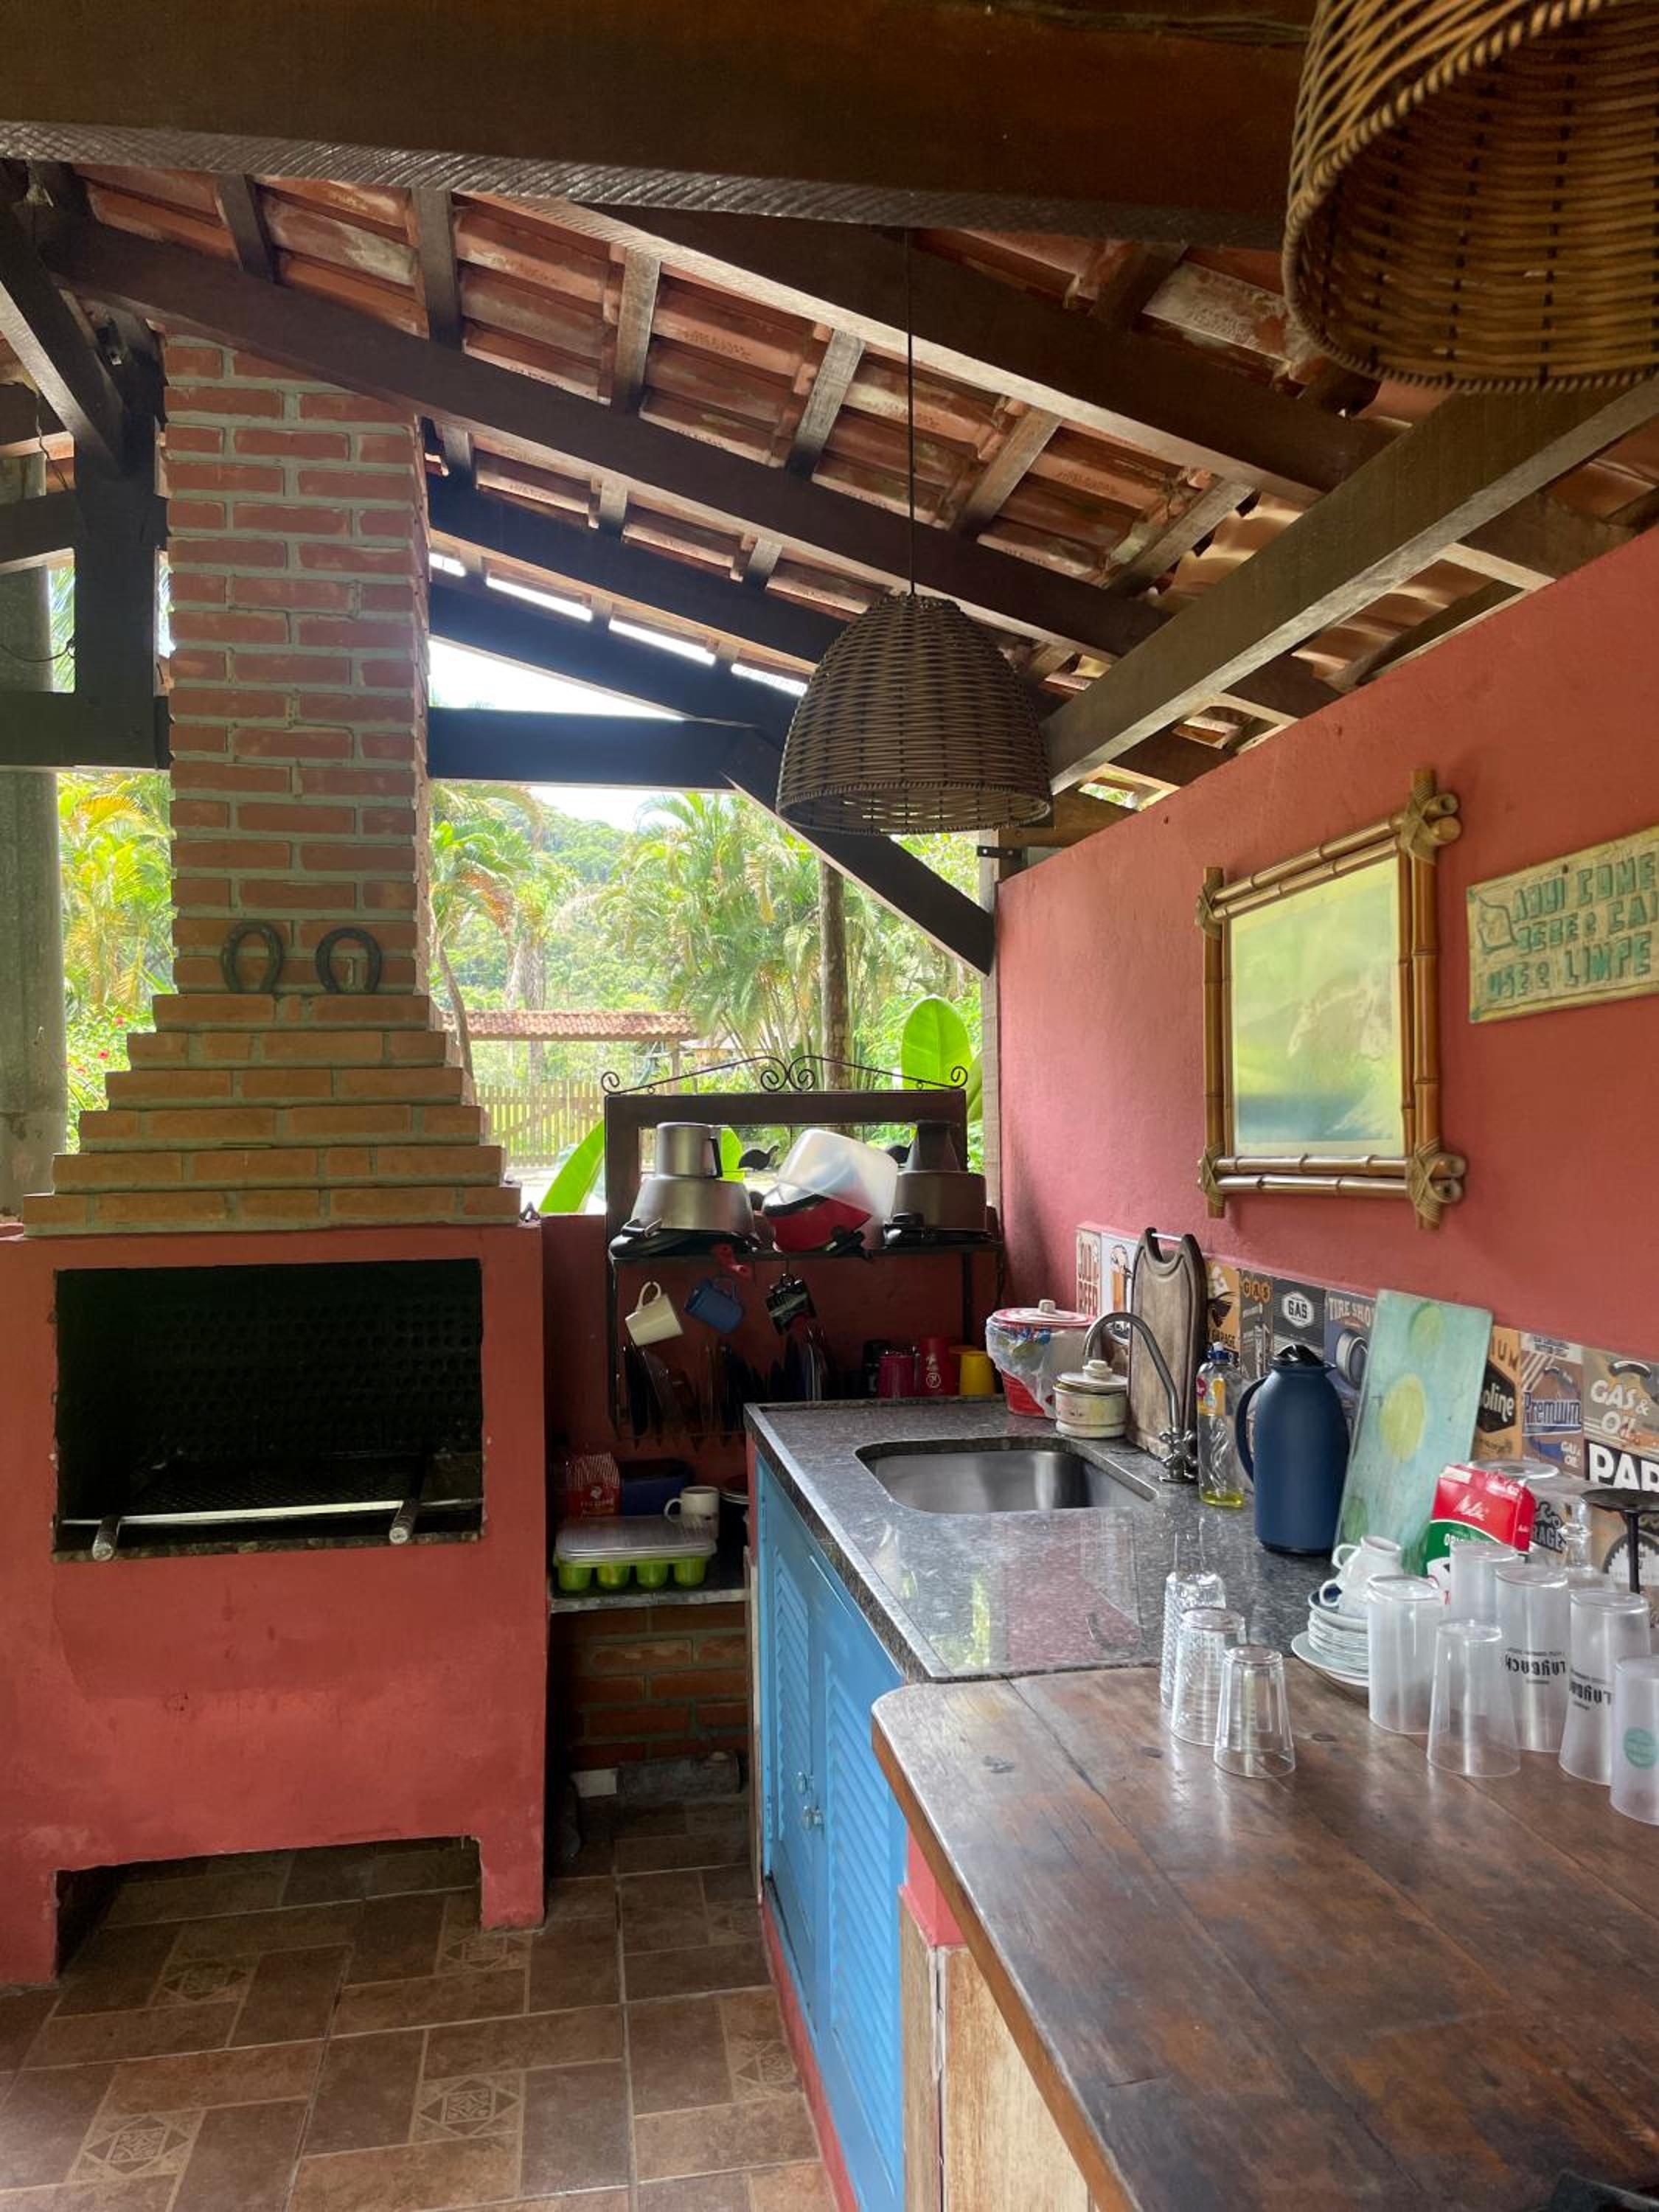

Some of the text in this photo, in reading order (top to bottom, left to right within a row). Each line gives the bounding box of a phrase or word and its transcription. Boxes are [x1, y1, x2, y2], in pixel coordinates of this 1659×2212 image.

[1288, 1300, 1308, 1320] GAS
[1329, 1297, 1374, 1327] TIRE SHO
[1524, 1391, 1582, 1425] Premium
[1590, 1380, 1636, 1410] GAS
